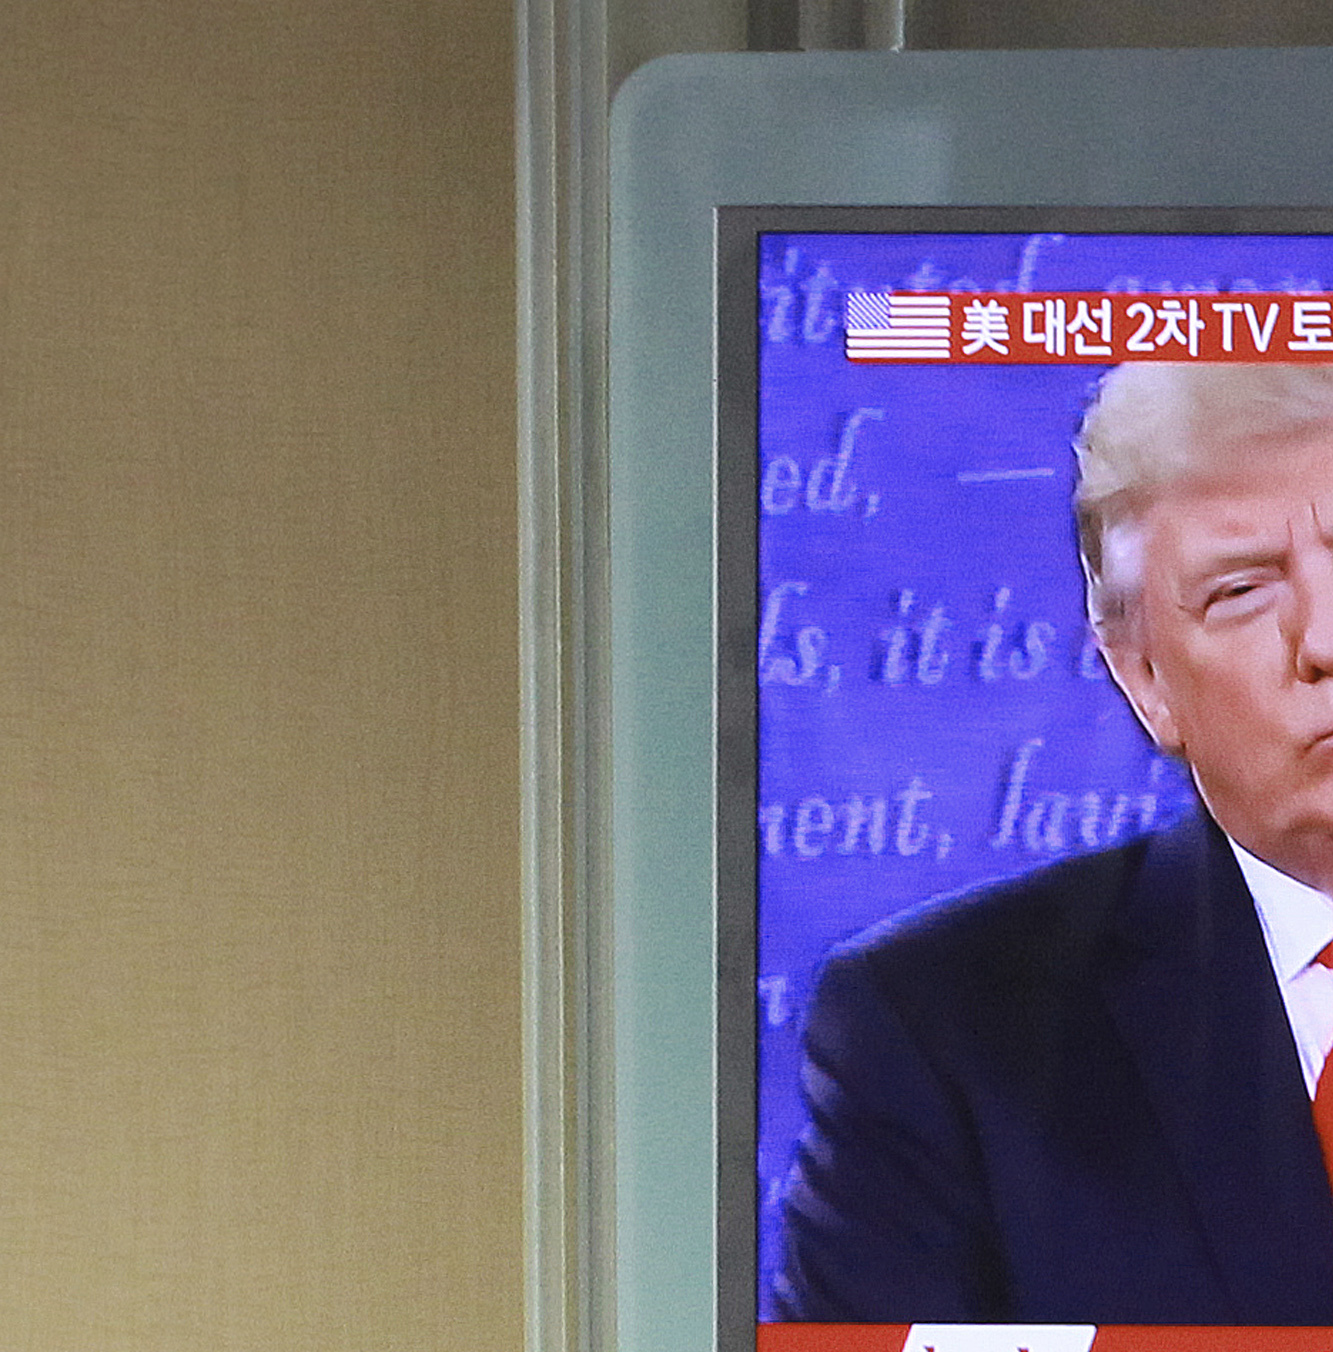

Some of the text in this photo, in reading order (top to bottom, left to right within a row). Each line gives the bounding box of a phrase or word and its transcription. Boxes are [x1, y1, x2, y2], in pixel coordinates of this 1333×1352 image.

[960, 298, 1010, 356] 美
[1023, 298, 1113, 357] 대선
[1125, 299, 1206, 357] 2차
[1211, 302, 1280, 353] TV
